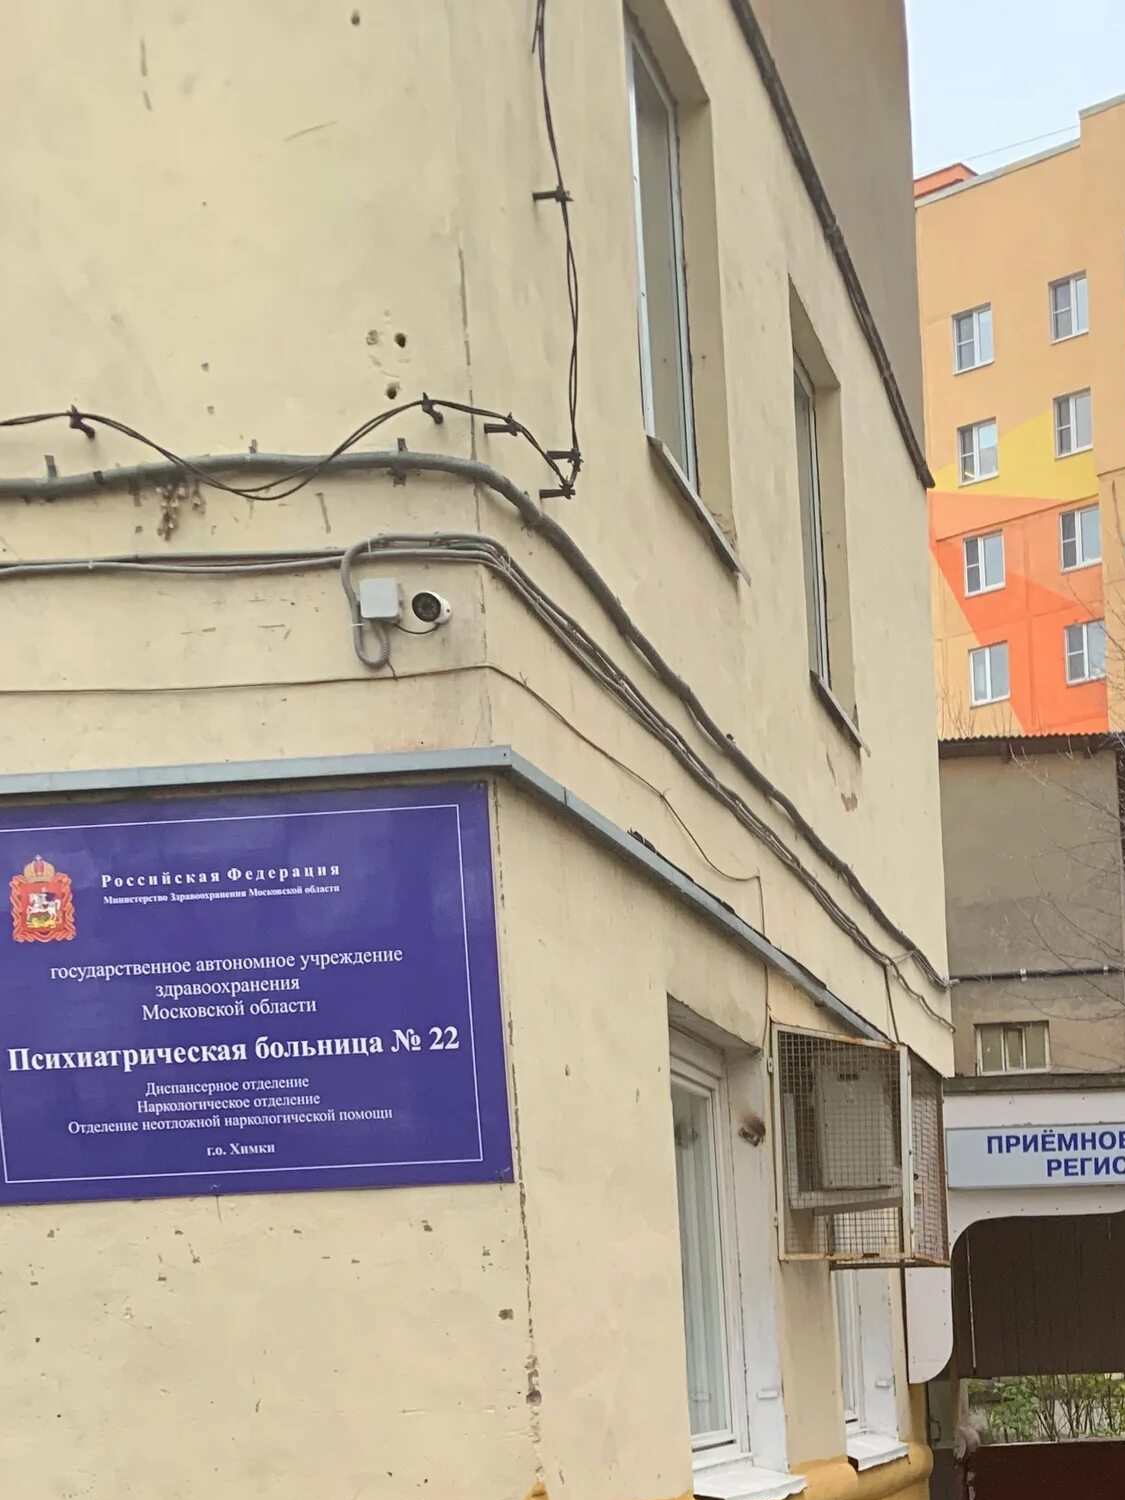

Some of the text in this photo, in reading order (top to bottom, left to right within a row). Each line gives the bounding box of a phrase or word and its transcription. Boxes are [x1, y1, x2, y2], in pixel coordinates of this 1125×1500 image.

[101, 866, 339, 889] Российская Федерация
[103, 883, 340, 905] Министерство Здравоохранения Московской области
[51, 949, 403, 983] государственное автономное учреждение
[156, 978, 300, 1001] здравоохранения
[142, 998, 317, 1021] Московской области
[7, 1025, 460, 1073] Психиатрическая больница № 22
[145, 1077, 310, 1098] Диспансерное отделение
[137, 1094, 321, 1116] Наркологическое отделение
[67, 1109, 393, 1135] Отделение неотложной наркологической помощи
[206, 1142, 275, 1157] г.о. Химки
